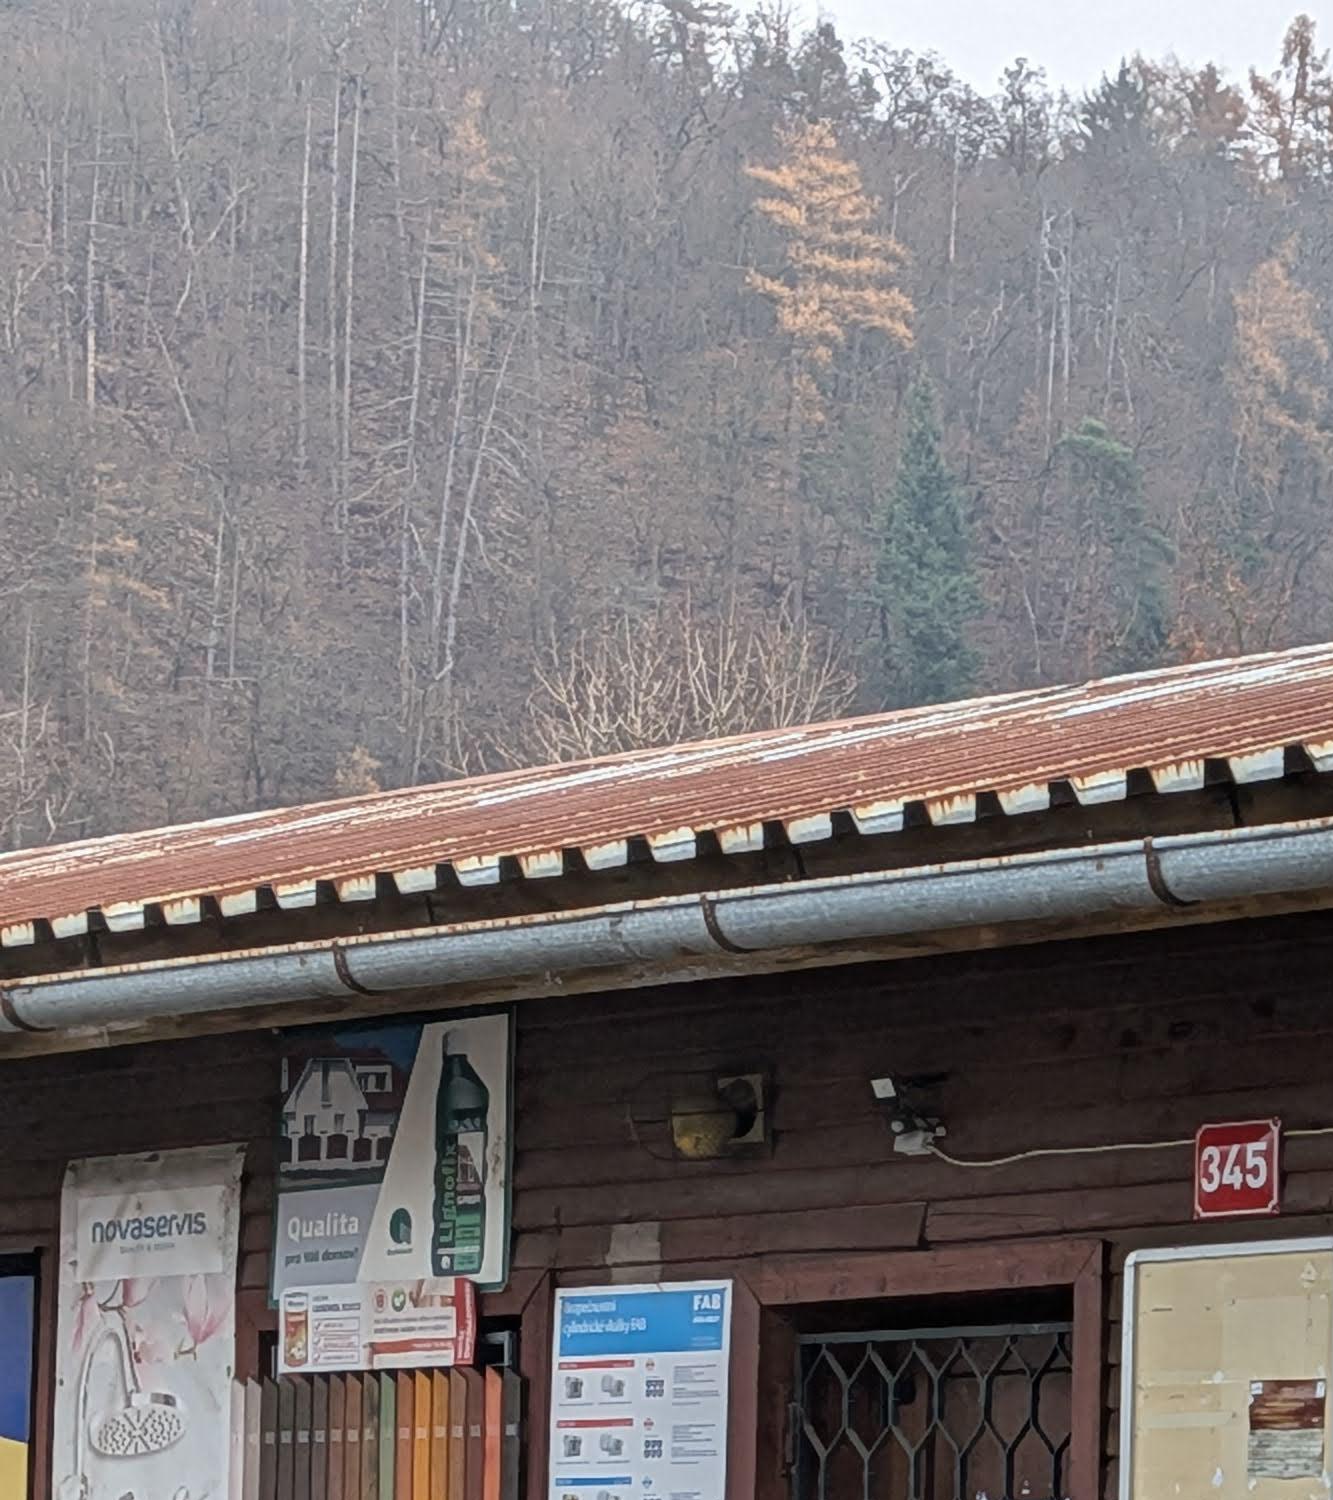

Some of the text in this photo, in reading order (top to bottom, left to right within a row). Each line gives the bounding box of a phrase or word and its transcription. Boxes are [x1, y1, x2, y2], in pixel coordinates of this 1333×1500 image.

[1200, 1141, 1267, 1193] 345
[91, 1212, 207, 1244] novaservis
[287, 1212, 359, 1242] Qualita
[693, 1293, 721, 1311] FAB
